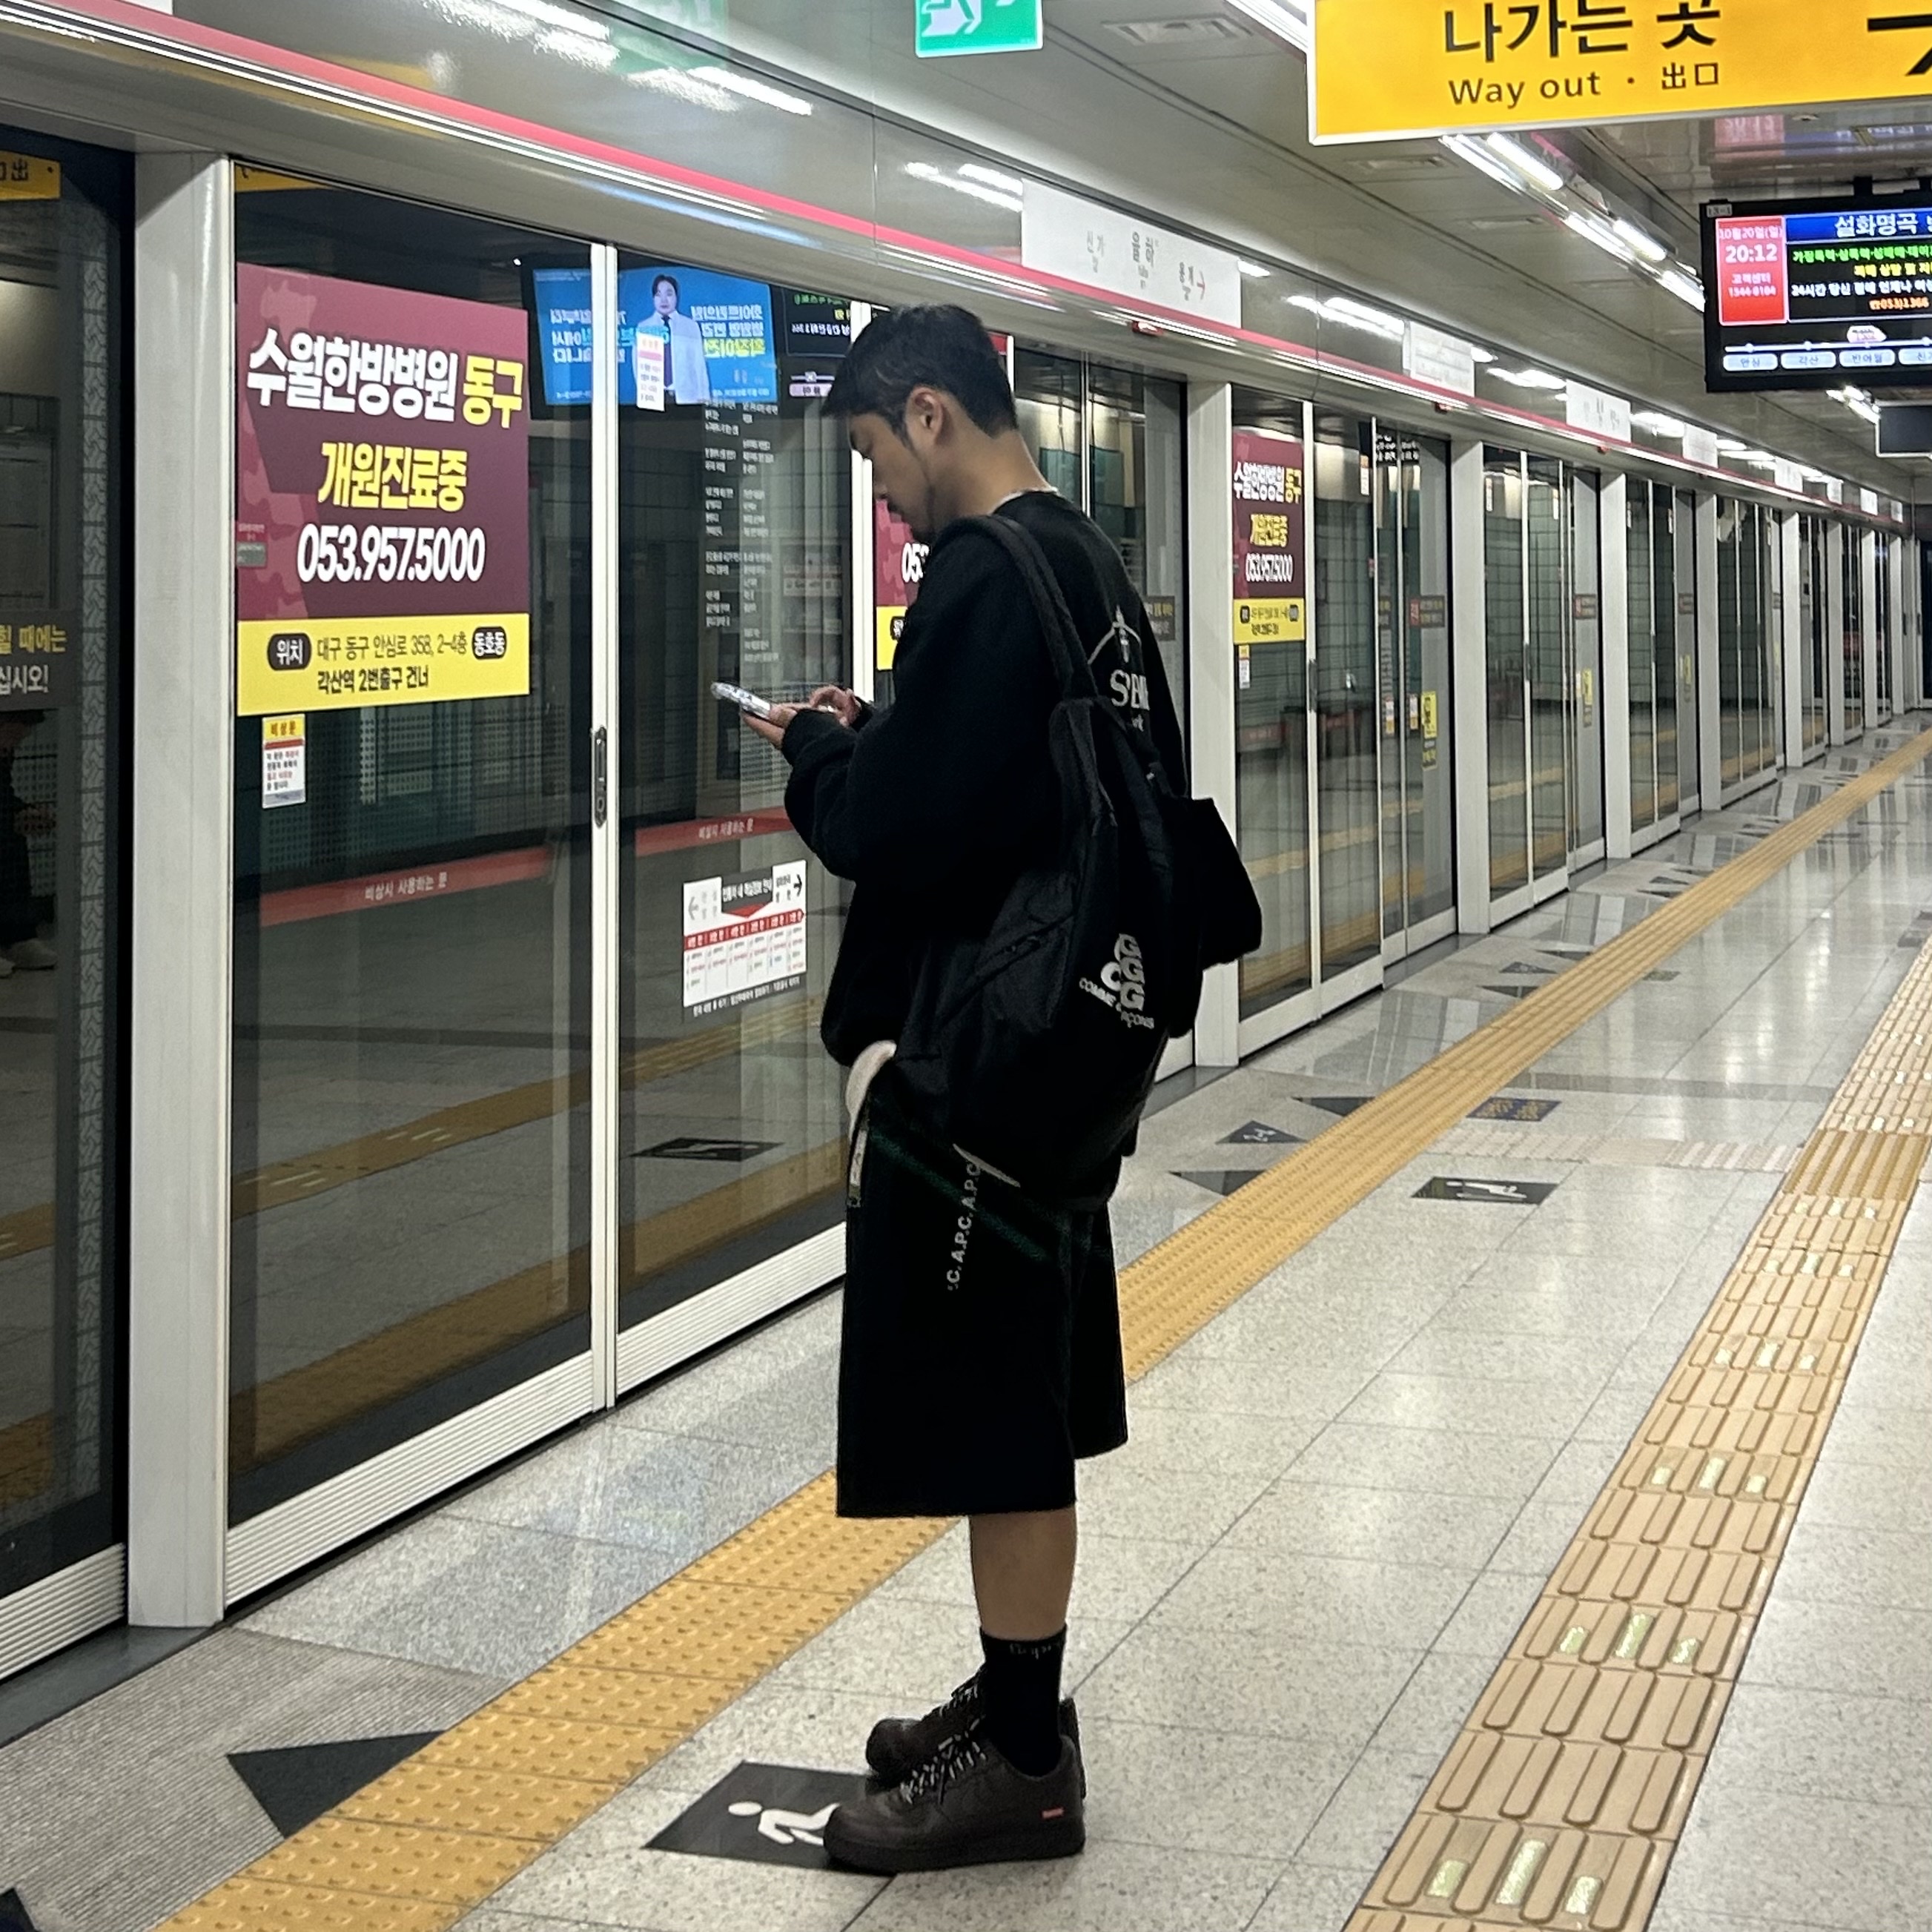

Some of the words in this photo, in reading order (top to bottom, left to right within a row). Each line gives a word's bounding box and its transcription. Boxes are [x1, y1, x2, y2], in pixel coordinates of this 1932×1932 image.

[1444, 0, 1633, 63] 나가는
[1449, 78, 1525, 110] Way
[1540, 71, 1601, 98] out
[1661, 62, 1720, 90] 出口
[1834, 212, 1919, 238] 설화명곡
[1725, 243, 1778, 263] 20:12
[1798, 355, 1819, 365] 각산
[248, 328, 458, 422] 수월한방병원
[463, 354, 523, 429] 동구
[317, 442, 468, 512] 개원진료중
[1285, 467, 1303, 504] 동구
[297, 523, 486, 582] 053.957.5000
[19, 624, 68, 654] 때에는
[276, 638, 303, 665] 위치
[317, 637, 341, 661] 대구
[345, 635, 369, 661] 동구
[374, 634, 407, 659] 안심로
[474, 631, 506, 656] 동호동
[317, 669, 355, 695] 각산역
[359, 666, 403, 692] 2번출구
[406, 665, 430, 689] 건너
[365, 881, 394, 901] 비상시
[397, 875, 434, 895] 사용하는
[438, 871, 448, 888] 문
